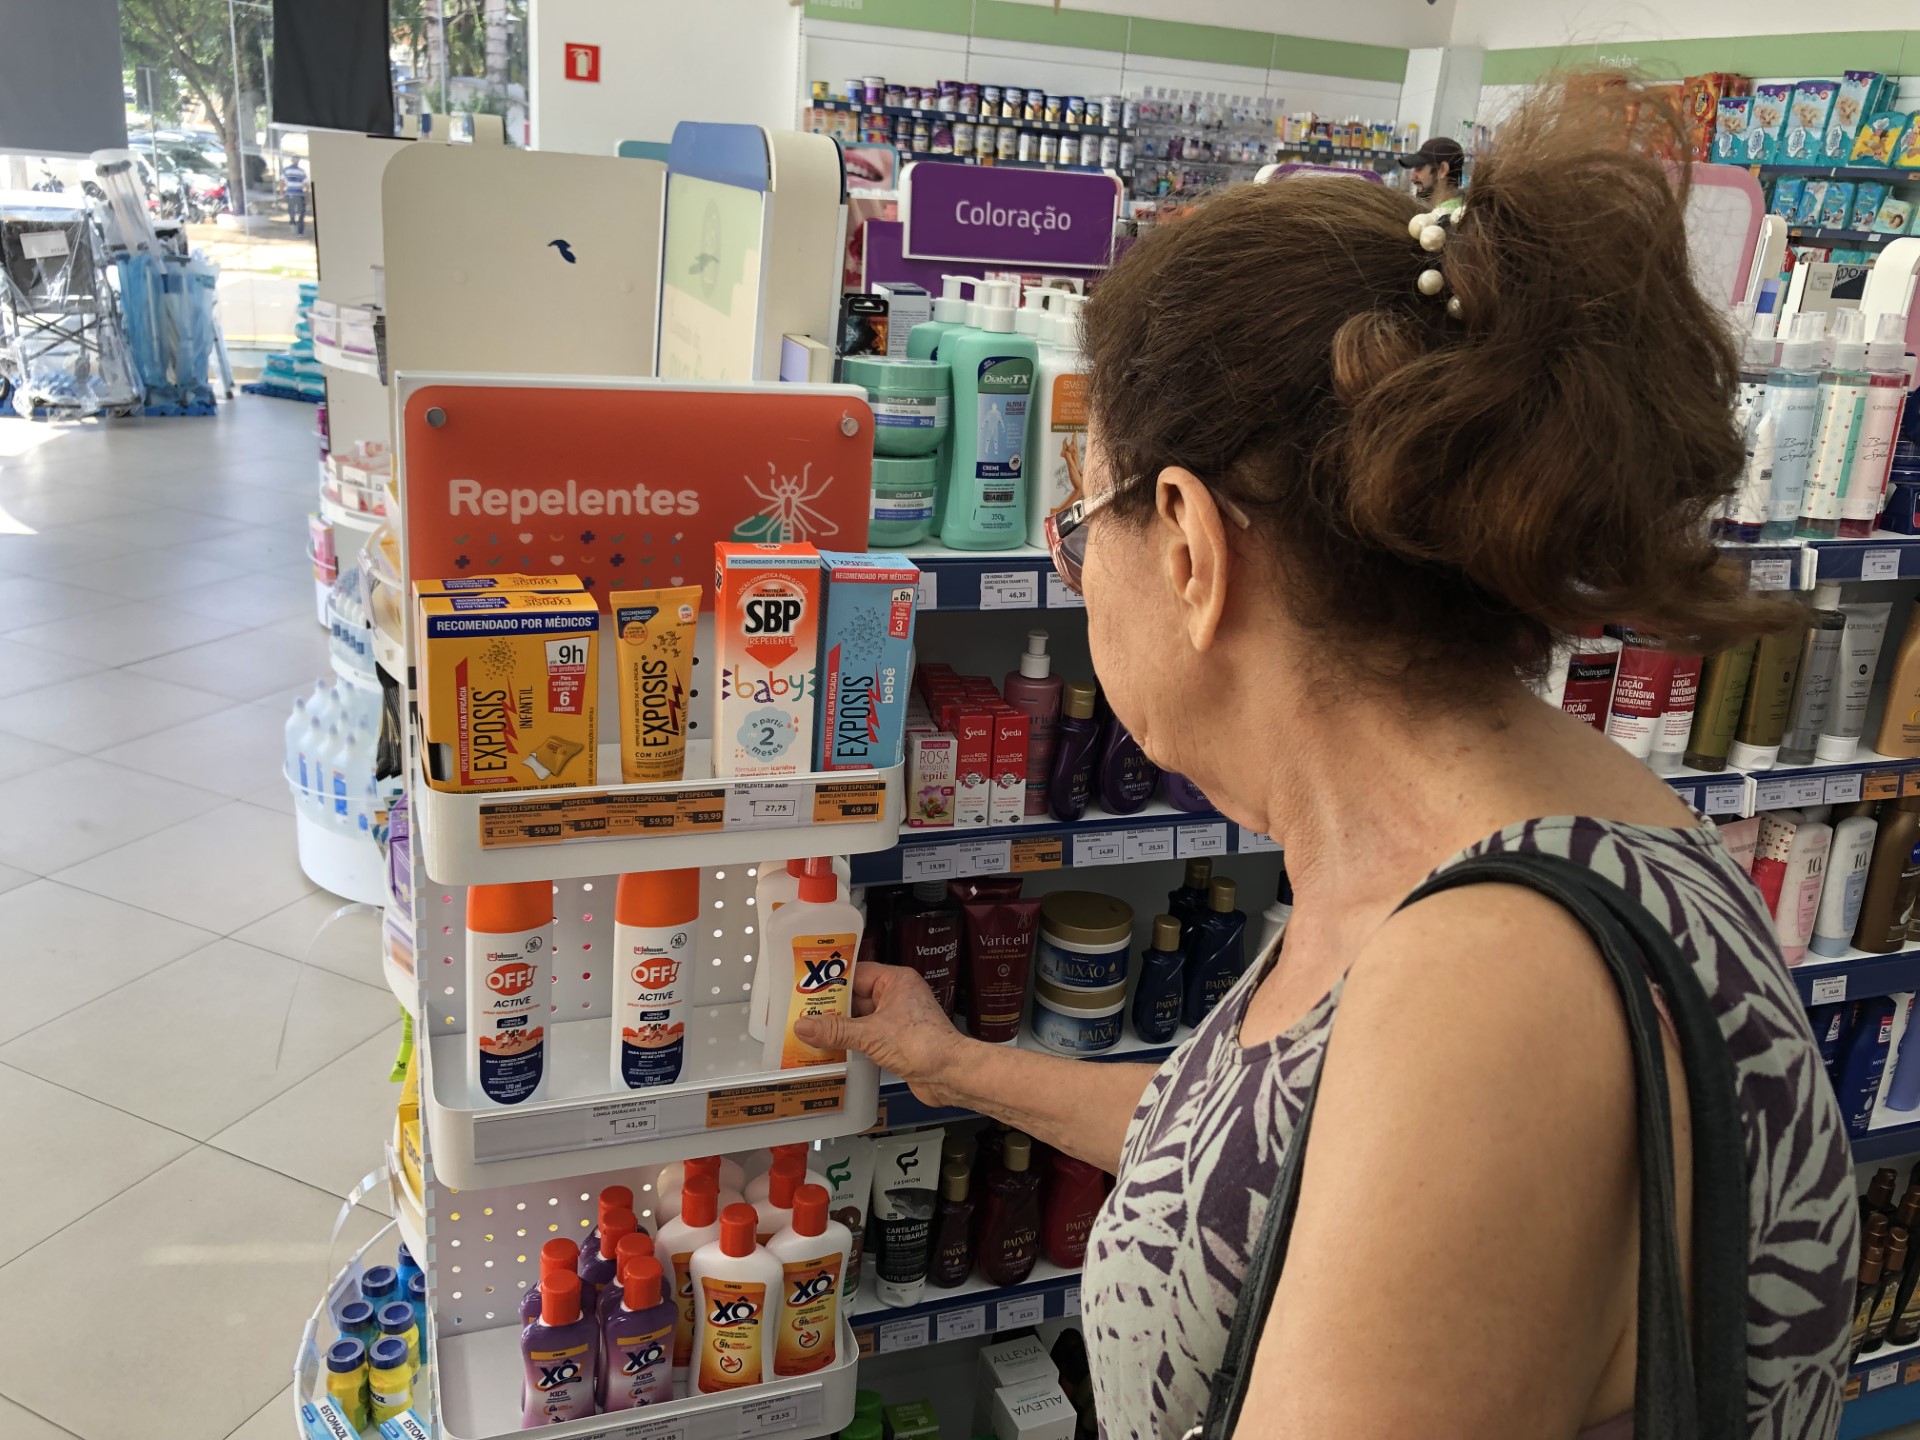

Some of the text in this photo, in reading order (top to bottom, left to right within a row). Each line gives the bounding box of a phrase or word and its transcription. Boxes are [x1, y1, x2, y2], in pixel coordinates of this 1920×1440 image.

[955, 200, 1072, 236] Coloração
[985, 374, 1029, 384] DiabetTX
[449, 479, 700, 524] Repelentes
[991, 513, 1005, 521] 350g
[835, 572, 877, 580] RECOMENDADO
[736, 580, 750, 595] LOÇÃO
[750, 572, 778, 586] COSMÉTICA
[900, 590, 911, 601] 6h
[1009, 591, 1026, 599] 46,39
[745, 600, 801, 633] SBP
[437, 619, 518, 631] RECOMENDADO
[521, 618, 542, 629] POR
[895, 620, 903, 632] 3
[749, 636, 795, 646] REPELENTE
[558, 645, 584, 665] 9h
[558, 665, 584, 673] proteção
[734, 664, 804, 704] baby
[882, 667, 896, 704] bebê
[1618, 679, 1643, 690] LOÇÃO
[1672, 678, 1691, 689] LOÇÃO
[1616, 687, 1655, 700] INTENSIVA
[1671, 685, 1697, 696] INTENSIVA
[559, 691, 570, 706] 6
[641, 660, 670, 748] EXPOSIS
[1615, 696, 1652, 707] HIDRATANTE
[1669, 694, 1695, 703] HIDRATANTE
[519, 686, 533, 729] INFANTIL
[1562, 703, 1587, 714] LOÇÃO
[824, 672, 838, 758] REPELENTE DE ALTA EFICÁCIA
[837, 675, 874, 757] EXPOSIS
[759, 717, 784, 728] partir
[461, 731, 467, 739] DE
[472, 689, 507, 772] EXPOSIS
[759, 727, 774, 746] 2
[964, 727, 987, 740] Sveda
[1000, 728, 1022, 741] Sveda
[751, 743, 783, 757] meses
[920, 750, 950, 765] ROSA
[495, 805, 518, 813] PREÇO
[765, 804, 787, 812] 27,75
[851, 806, 873, 814] 49,99
[649, 817, 673, 825] 59,99
[698, 812, 721, 820] 59,99
[534, 826, 560, 834] 59,99
[580, 820, 604, 828] 59,99
[979, 933, 1030, 946] Varicell
[916, 939, 958, 957] Venocel
[945, 951, 957, 962] GEL
[632, 961, 679, 983] OFF!
[802, 950, 846, 988] XÔ
[1055, 957, 1105, 979] PAIXÃO
[487, 966, 536, 990] OFF!
[494, 996, 532, 1008] ACTIVE
[638, 991, 674, 1001] ACTIVE
[1156, 996, 1182, 1010] PAIXÃO
[1078, 1021, 1120, 1042] PAIXÃO
[752, 1105, 773, 1113] 25,99
[625, 1120, 648, 1129] 41,99
[894, 1177, 921, 1186] FASHION
[886, 1222, 929, 1234] CARTILAGEM
[897, 1229, 928, 1241] TUBARÃO
[1003, 1231, 1037, 1249] PAIXÃO
[792, 1270, 833, 1303] XÔ
[713, 1296, 755, 1323] XÔ
[799, 1318, 810, 1327] 9h
[718, 1340, 731, 1349] 9h
[626, 1341, 663, 1371] XÔ
[993, 1345, 1042, 1365] ALLEVIA
[540, 1359, 579, 1387] XÔ
[636, 1371, 653, 1381] KIDS
[549, 1389, 568, 1398] KIDS
[1011, 1394, 1062, 1416] ALLEVIA
[770, 1412, 790, 1421] 23,55
